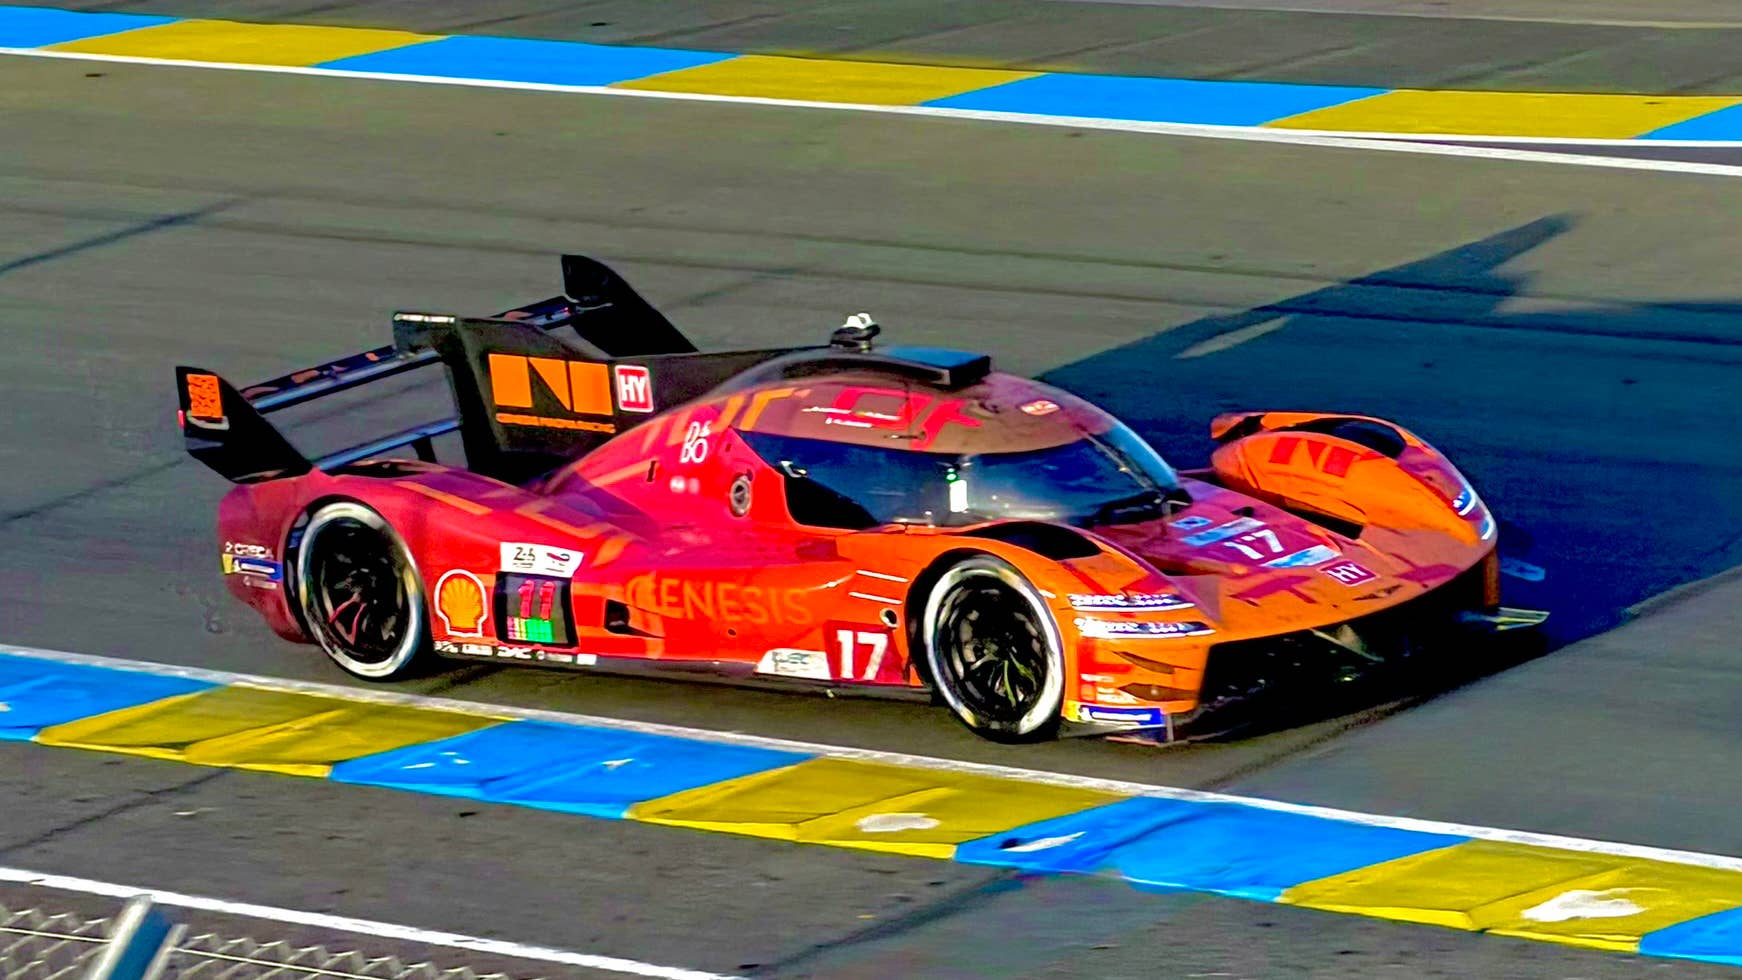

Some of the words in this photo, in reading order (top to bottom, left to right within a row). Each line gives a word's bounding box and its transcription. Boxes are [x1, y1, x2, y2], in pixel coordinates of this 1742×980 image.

[620, 374, 647, 403] HY
[1223, 529, 1285, 560] 17
[1326, 563, 1368, 583] HY
[625, 570, 814, 625] GENESIS
[836, 629, 889, 680] 17
